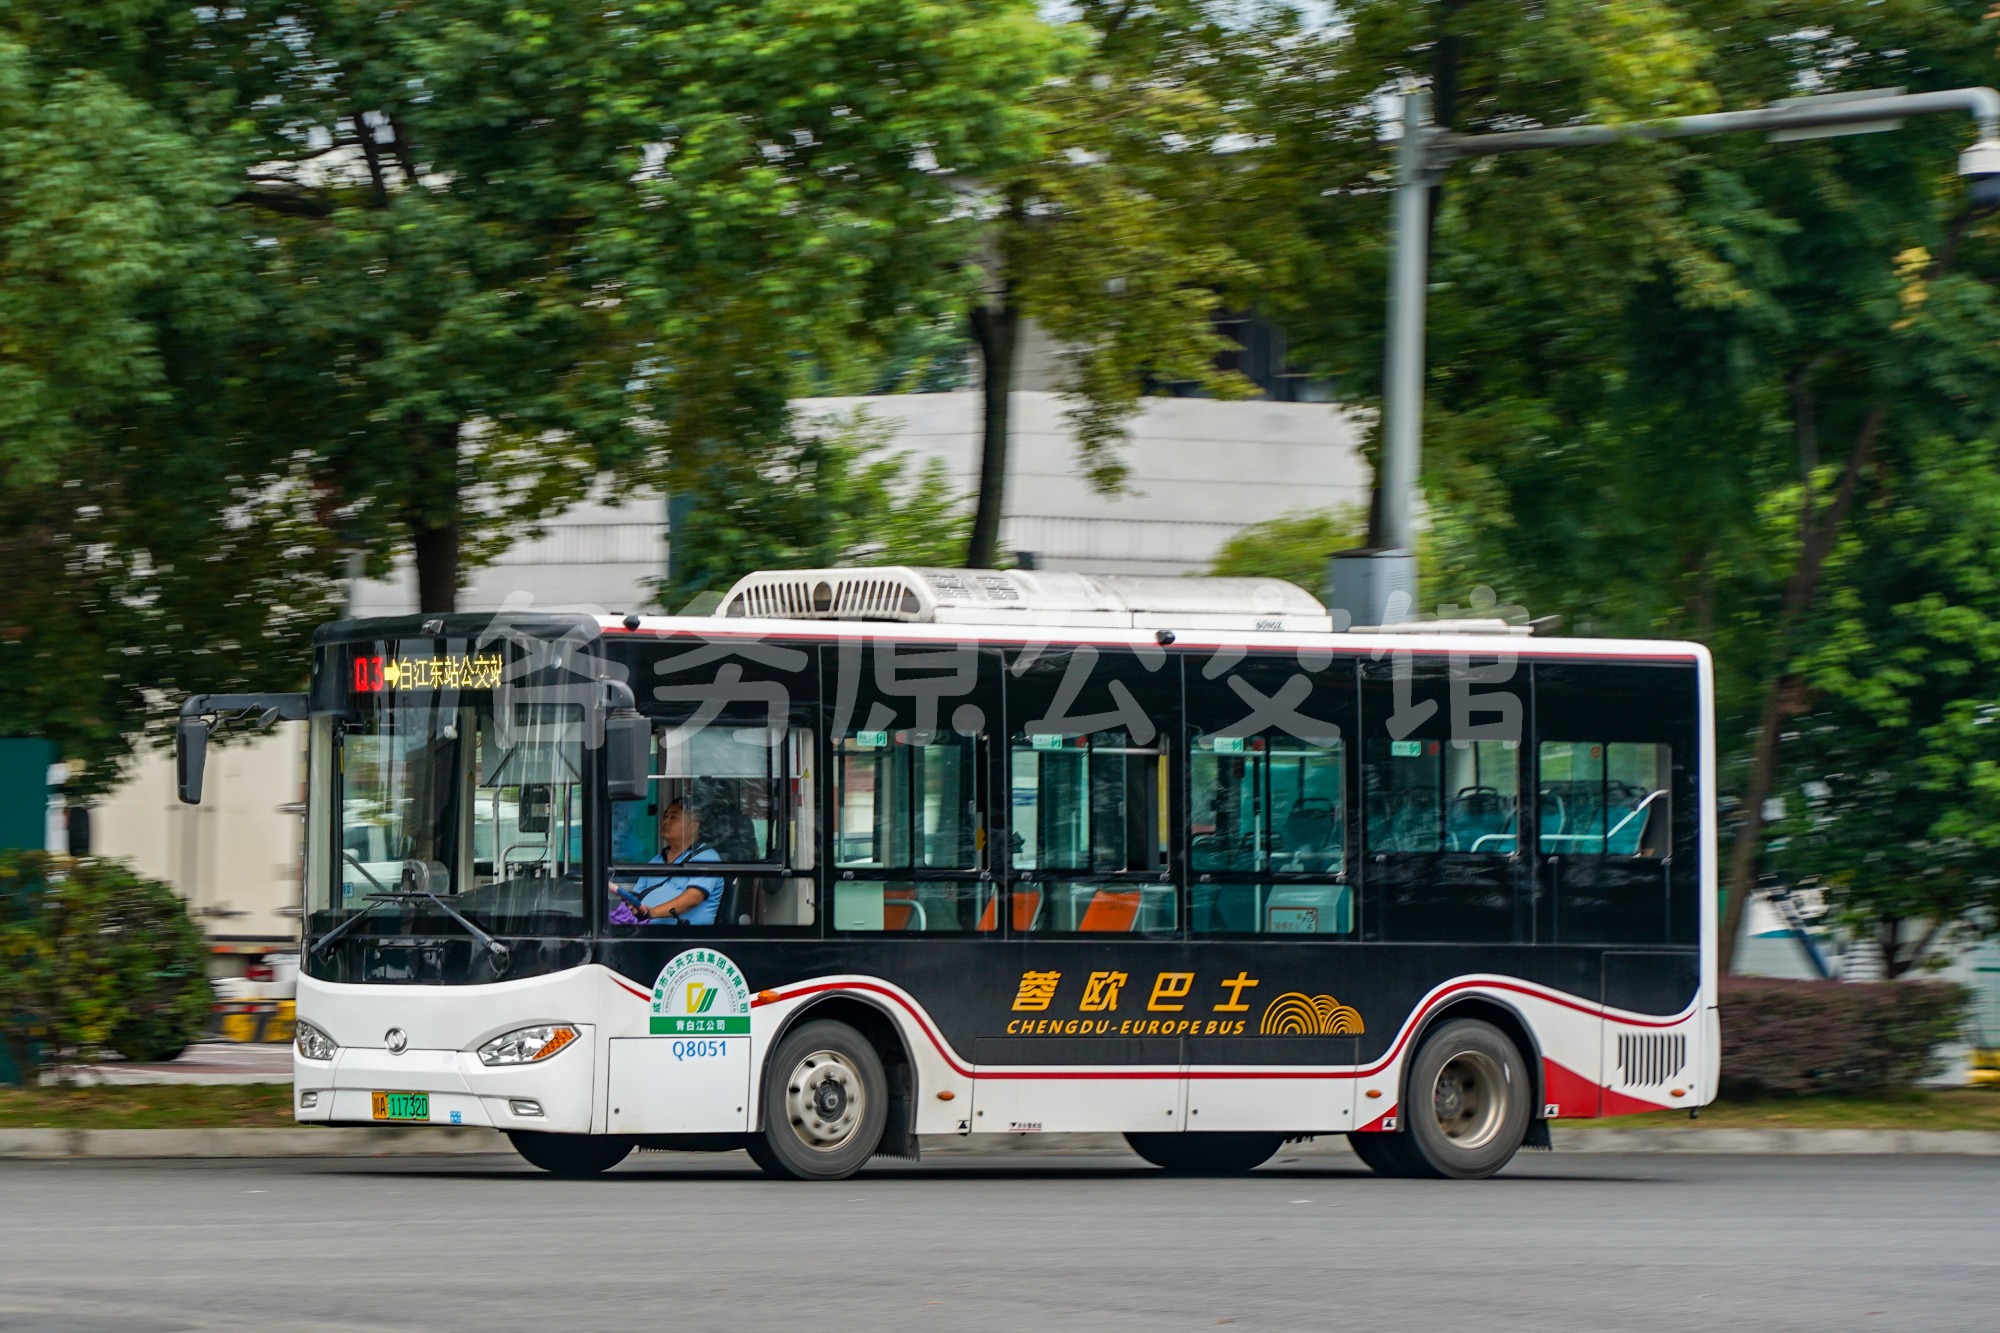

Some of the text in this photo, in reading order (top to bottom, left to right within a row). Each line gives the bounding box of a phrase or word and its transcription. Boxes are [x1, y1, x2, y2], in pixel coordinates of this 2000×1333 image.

[354, 656, 384, 691] Q3
[652, 951, 749, 1013] 成都市公共交通集团有限公司
[1011, 970, 1259, 1011] 蓉欧巴士
[676, 1019, 725, 1031] 青白江公司
[1006, 1019, 1246, 1034] CHENGDU-EUROPE BUS
[672, 1040, 727, 1061] Q8051
